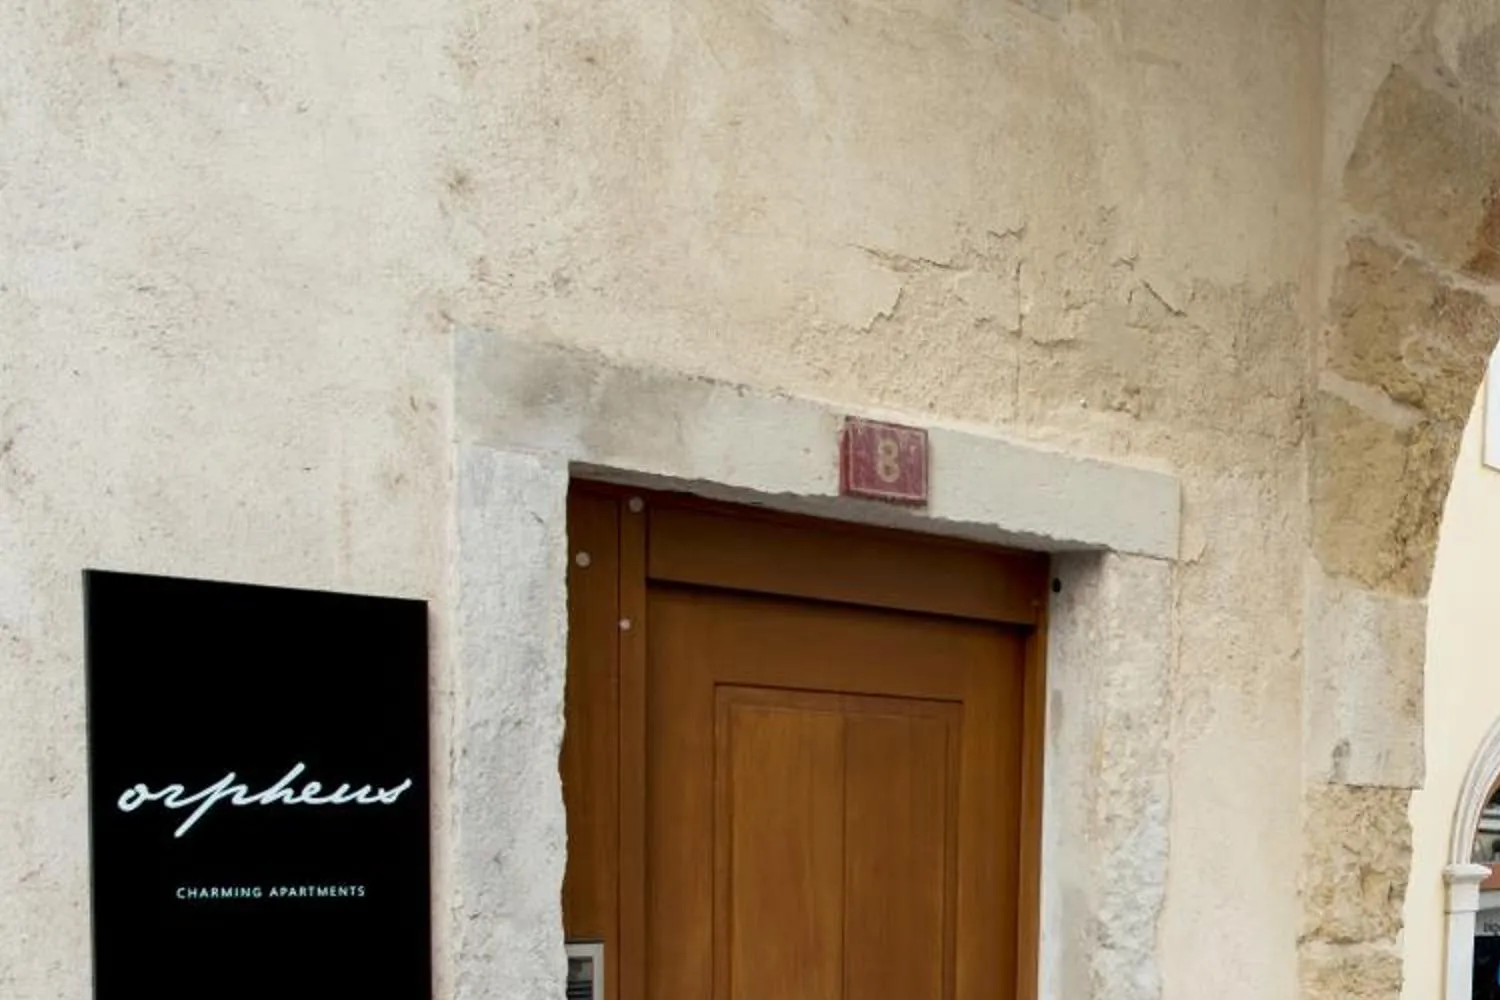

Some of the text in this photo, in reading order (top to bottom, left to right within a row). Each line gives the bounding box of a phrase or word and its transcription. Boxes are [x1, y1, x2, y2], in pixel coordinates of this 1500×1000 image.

[876, 438, 901, 483] 8
[117, 762, 412, 838] orpheus
[176, 885, 366, 900] CHARMING APARTMENTS
